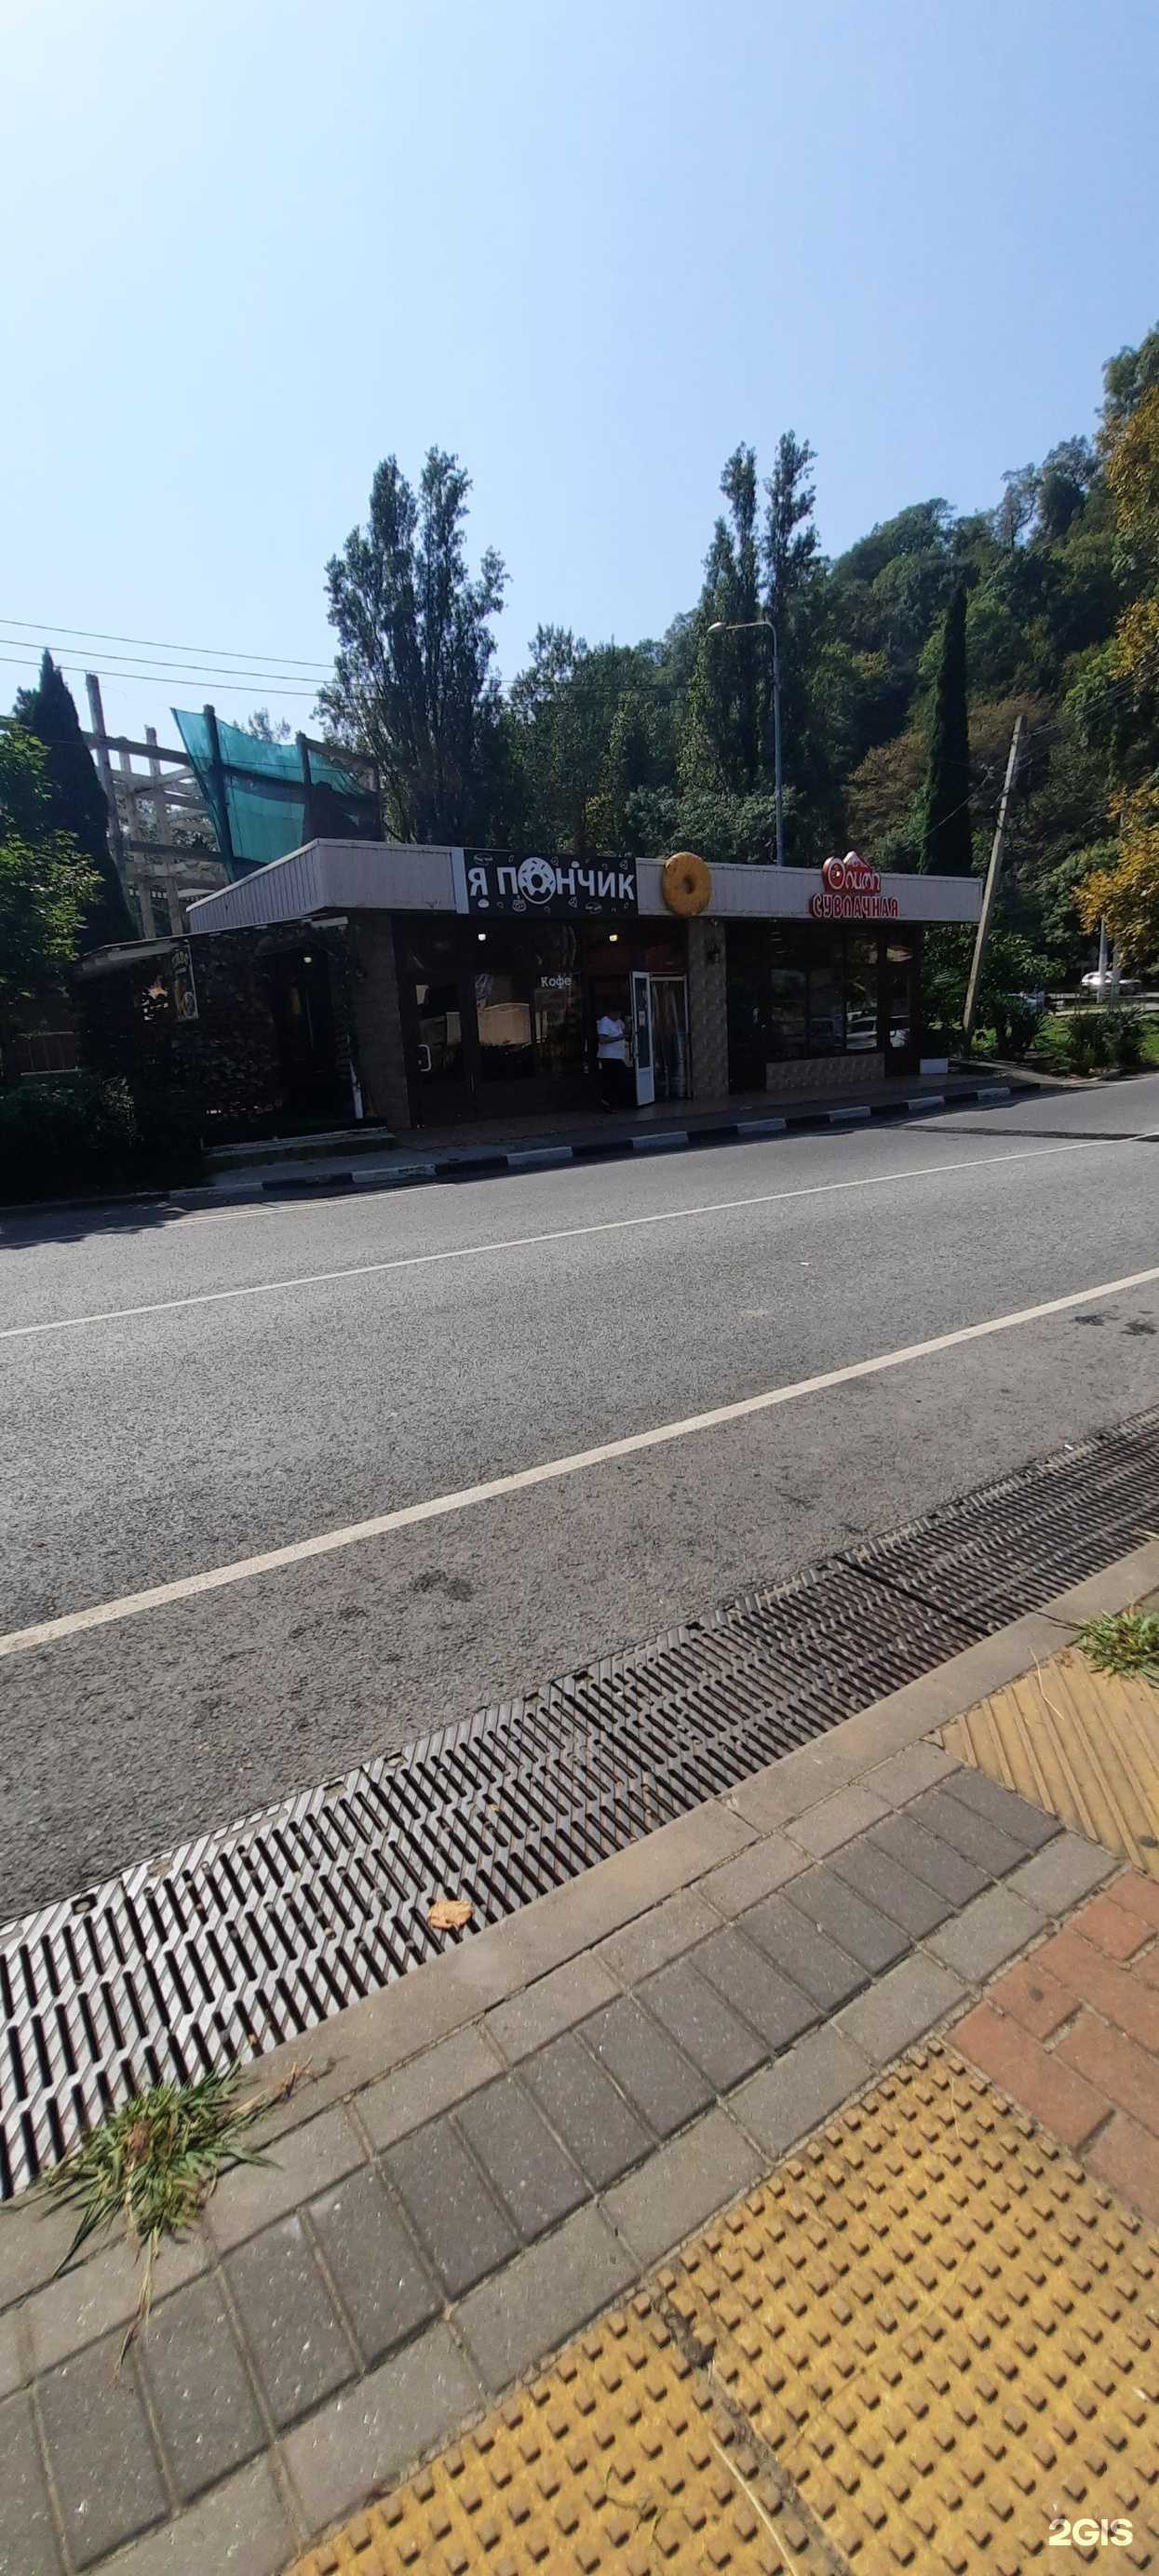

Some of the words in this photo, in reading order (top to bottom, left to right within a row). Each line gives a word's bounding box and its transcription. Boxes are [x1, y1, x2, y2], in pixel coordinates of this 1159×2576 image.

[467, 867, 488, 896] Я
[496, 856, 635, 905] ПОНЧИК
[813, 893, 899, 919] СУВЛАЧНАЯ
